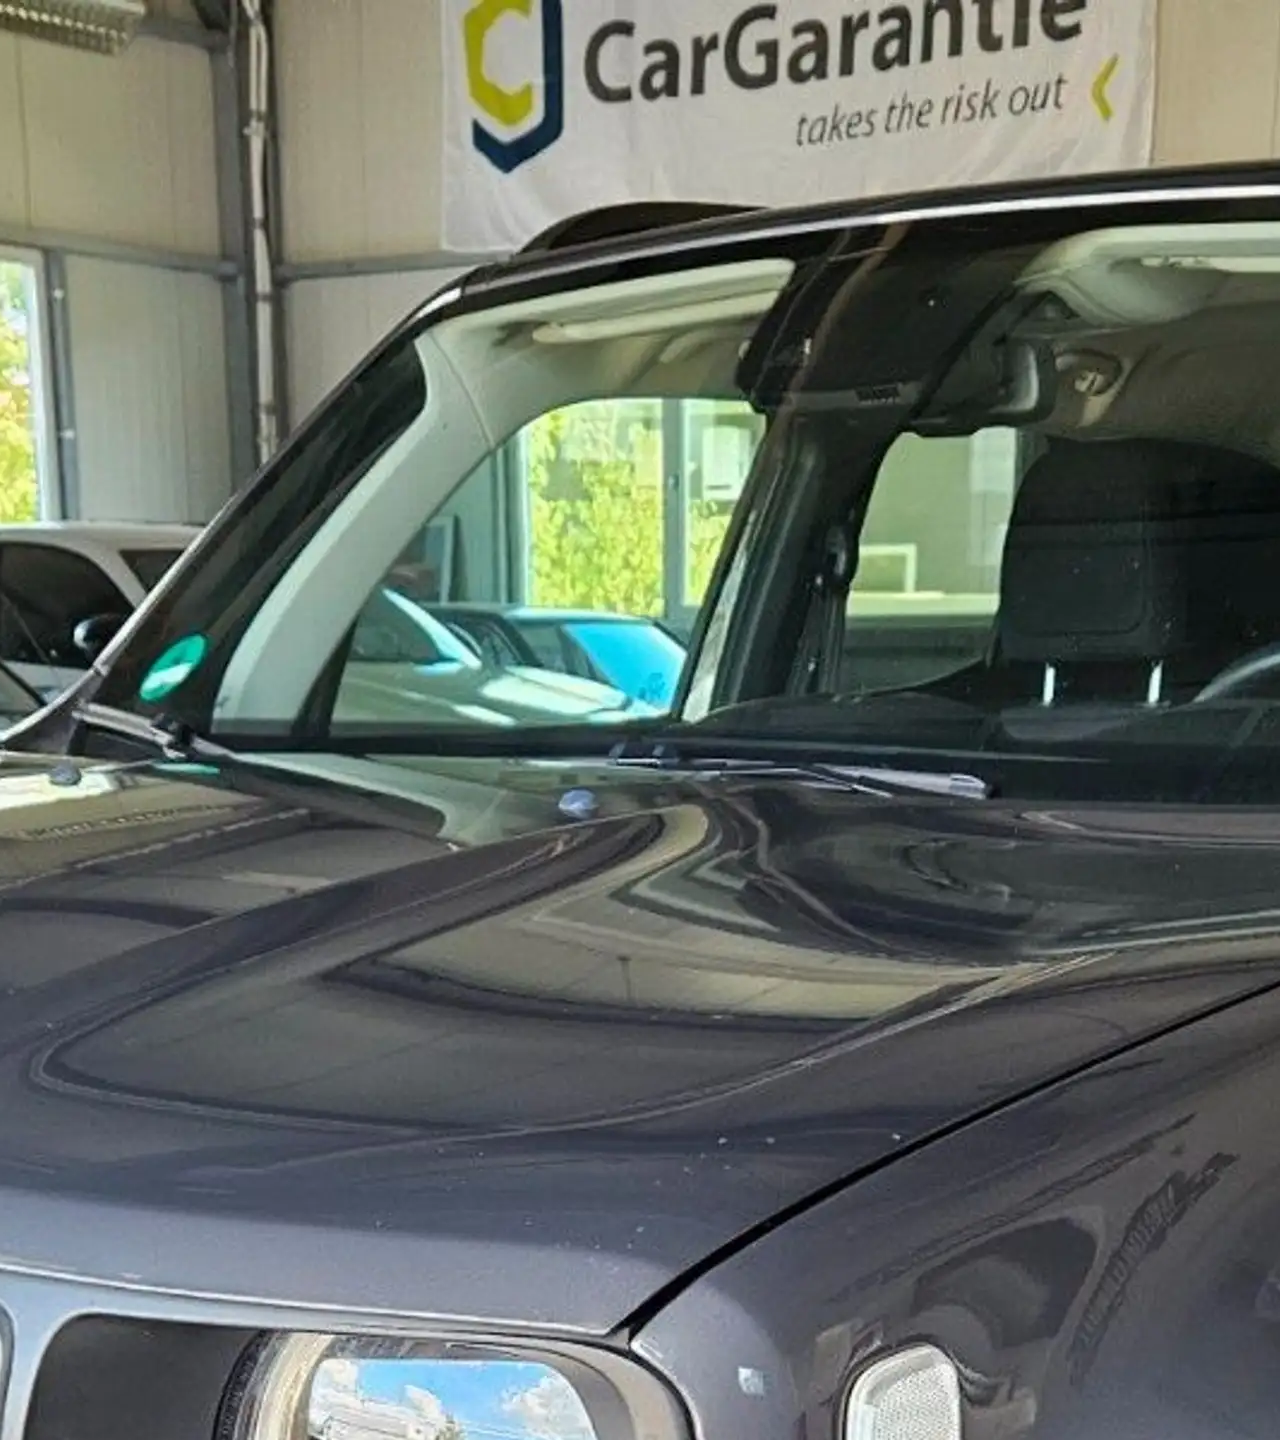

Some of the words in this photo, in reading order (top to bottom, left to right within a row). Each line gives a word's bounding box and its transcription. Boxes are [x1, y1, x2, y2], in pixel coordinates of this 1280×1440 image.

[583, 0, 1087, 104] CarGarantie
[796, 103, 877, 147] takes
[884, 90, 934, 133] the
[940, 76, 1001, 125] risk
[1007, 72, 1068, 118] out
